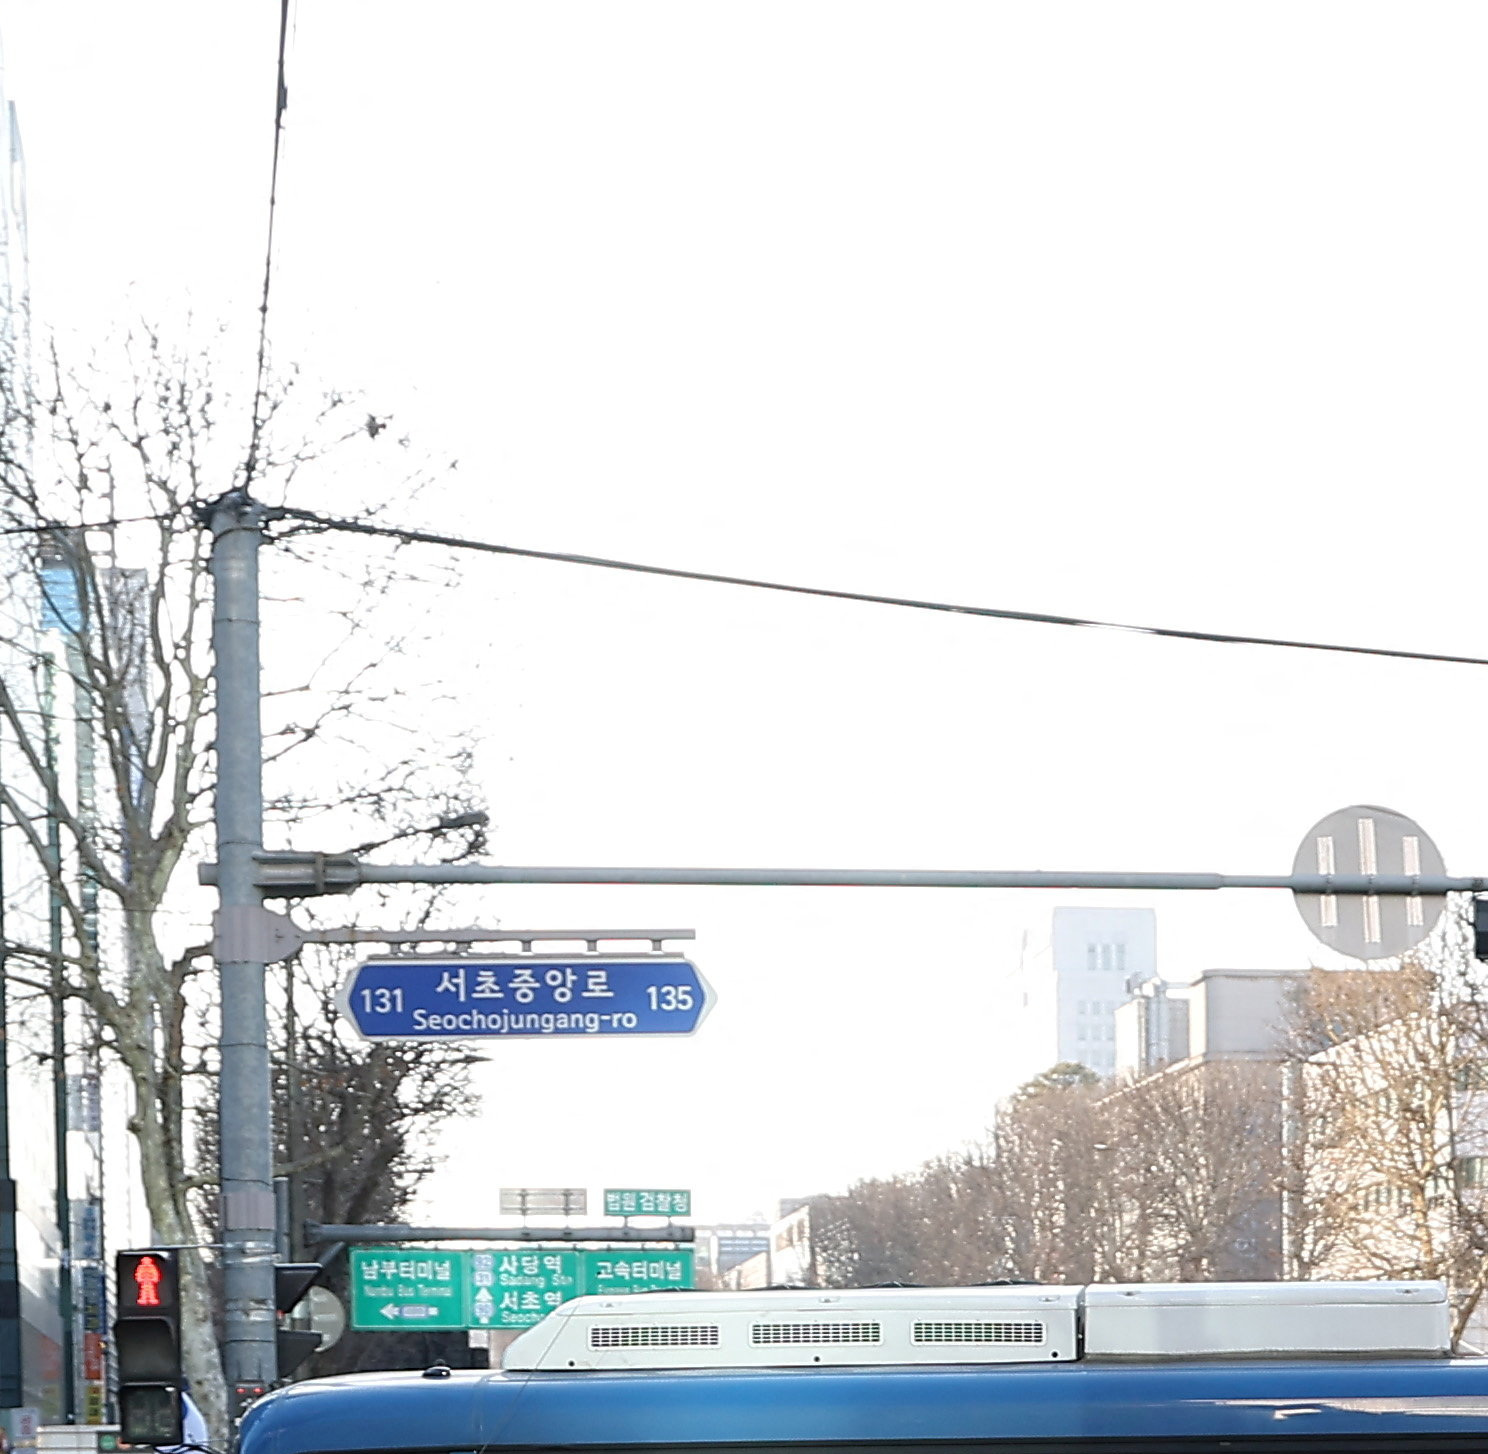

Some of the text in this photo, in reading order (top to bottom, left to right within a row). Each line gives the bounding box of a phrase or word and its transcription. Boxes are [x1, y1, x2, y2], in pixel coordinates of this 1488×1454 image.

[436, 968, 614, 1003] 서초중앙로
[360, 988, 404, 1014] 131
[646, 985, 694, 1011] 135
[413, 1009, 638, 1033] Seochojungang-ro
[362, 1260, 452, 1280] 남부터미널
[499, 1254, 562, 1274] 사당역
[597, 1260, 681, 1280] 고속터미널
[499, 1291, 563, 1310] 서초역
